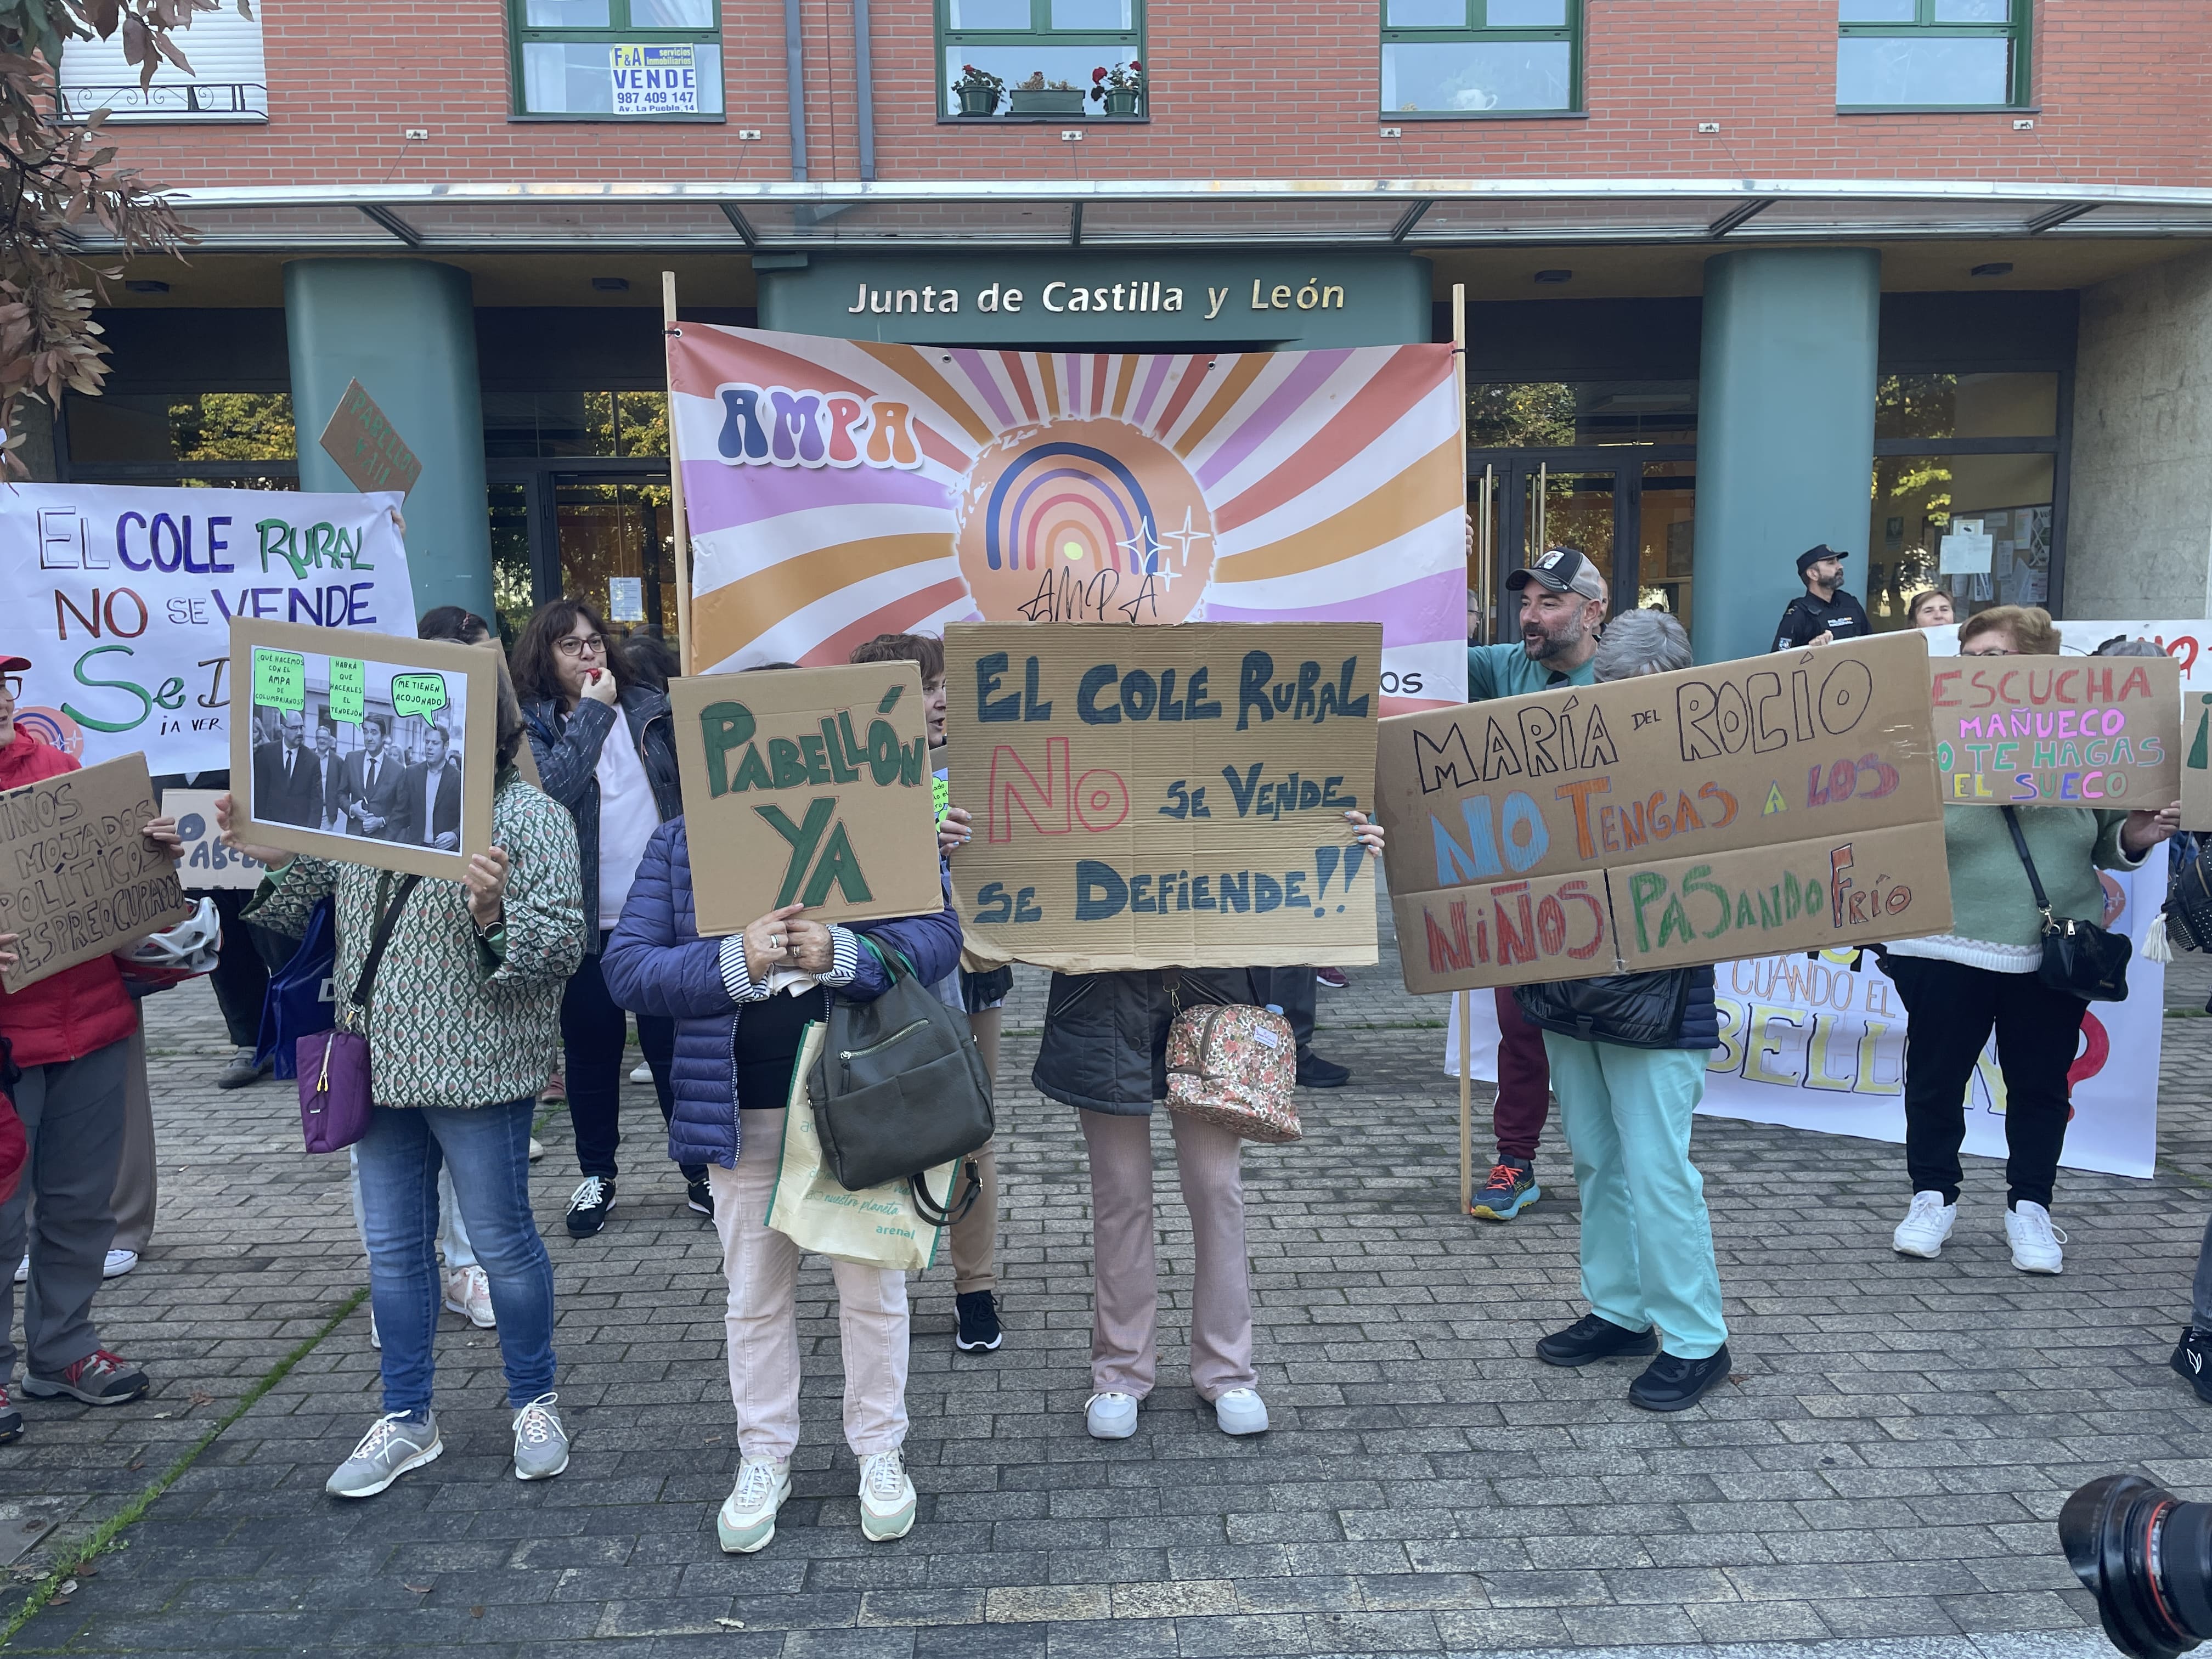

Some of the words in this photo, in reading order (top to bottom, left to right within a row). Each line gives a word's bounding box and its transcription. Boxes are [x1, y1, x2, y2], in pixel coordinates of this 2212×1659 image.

[646, 57, 691, 65] inmobiliarios
[659, 48, 691, 57] servicios
[613, 69, 695, 89] VENDE
[617, 92, 639, 104] 987
[644, 92, 667, 103] 409
[672, 92, 693, 103] 147
[848, 283, 959, 313] Junta
[977, 283, 1023, 312] de
[1042, 280, 1184, 312] Castilla
[1204, 286, 1228, 319] y
[1251, 278, 1345, 311] León
[716, 386, 921, 467] AMPA
[37, 506, 111, 570] EL
[116, 511, 234, 574] COLE
[255, 518, 375, 580] RURAL
[1017, 566, 1159, 624] AMPA
[55, 587, 148, 641] NO
[166, 596, 210, 625] SE
[211, 582, 377, 628] VENDE
[268, 665, 281, 673] CON
[275, 655, 305, 667] HACEMOS
[335, 660, 357, 670] HABRÁ
[339, 673, 353, 681] QUE
[268, 675, 291, 686] AMPA
[329, 682, 363, 695] HACERLES
[398, 680, 410, 689] ME
[411, 681, 441, 693] TIENEN
[975, 652, 1053, 723] EL
[1076, 663, 1222, 725] COLE
[1235, 650, 1370, 732] RURAL
[1932, 666, 2153, 708] ESCUCHA
[255, 693, 304, 706] COLUMBRIANOS?
[395, 693, 443, 707] ACOJONADO
[191, 717, 224, 731] VER
[1413, 695, 1620, 795] MARÍA
[1631, 709, 1663, 731] DEL
[1676, 651, 1872, 762] ROCÍO
[1959, 707, 2126, 739] MAÑUECO
[699, 684, 926, 799] PABELLÓN
[1965, 742, 2020, 774] TE
[2032, 736, 2166, 769] HAGAS
[989, 737, 1130, 844] NO
[1158, 780, 1211, 820] SE
[1221, 762, 1357, 821] VENDE
[1953, 772, 1994, 799] EL
[2010, 771, 2129, 800] SUECO
[1429, 790, 1551, 887] NO
[1554, 775, 1739, 861] TENGAS
[1761, 780, 1788, 817] A
[1807, 752, 1900, 809] LOS
[15, 799, 155, 879] MOJADOS
[751, 796, 876, 912] YA
[973, 882, 1043, 924] SE
[1628, 864, 1824, 953] PASANDO
[1830, 842, 1912, 928] FRÍO
[1865, 980, 1896, 1019] EL
[823, 1192, 860, 1207] nuestro
[857, 1198, 903, 1215] planeta
[876, 1226, 916, 1240] arenal
